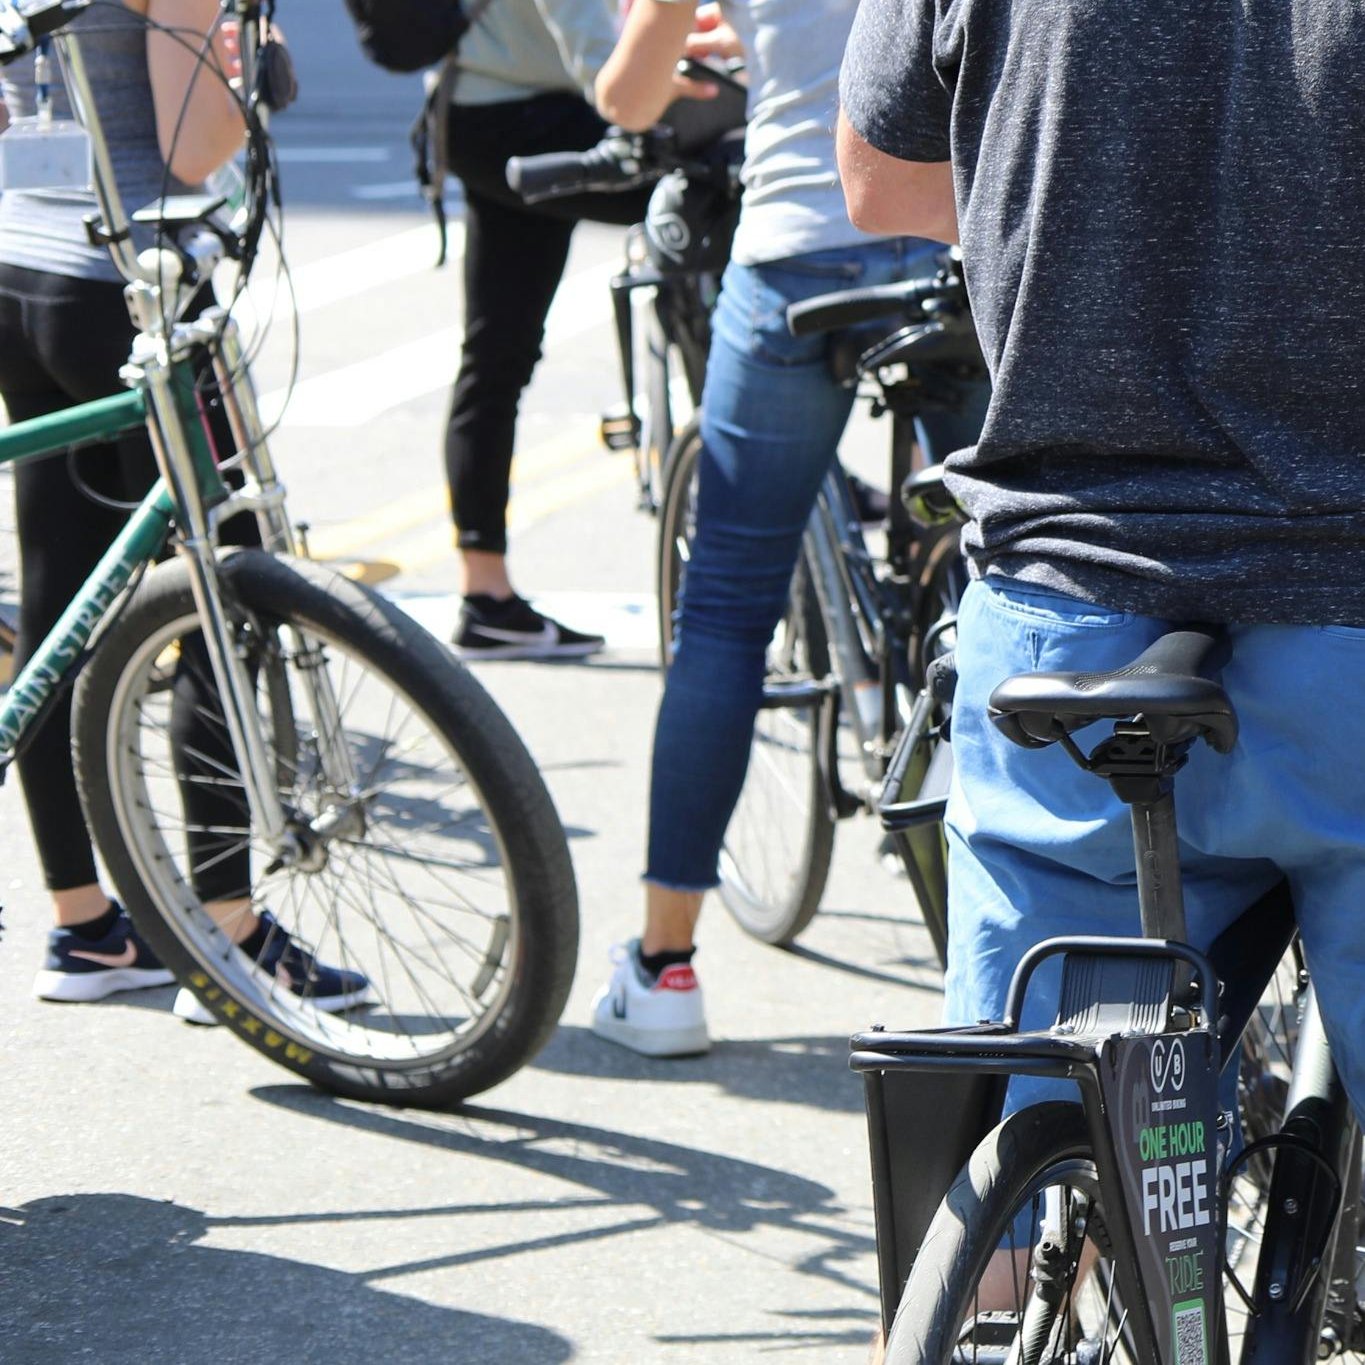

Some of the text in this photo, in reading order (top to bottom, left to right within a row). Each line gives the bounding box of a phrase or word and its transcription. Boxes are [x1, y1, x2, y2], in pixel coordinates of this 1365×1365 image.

[1139, 1121, 1206, 1161] ONE HOUR
[1141, 1158, 1211, 1236] FREE
[1165, 1249, 1205, 1295] RIDE
